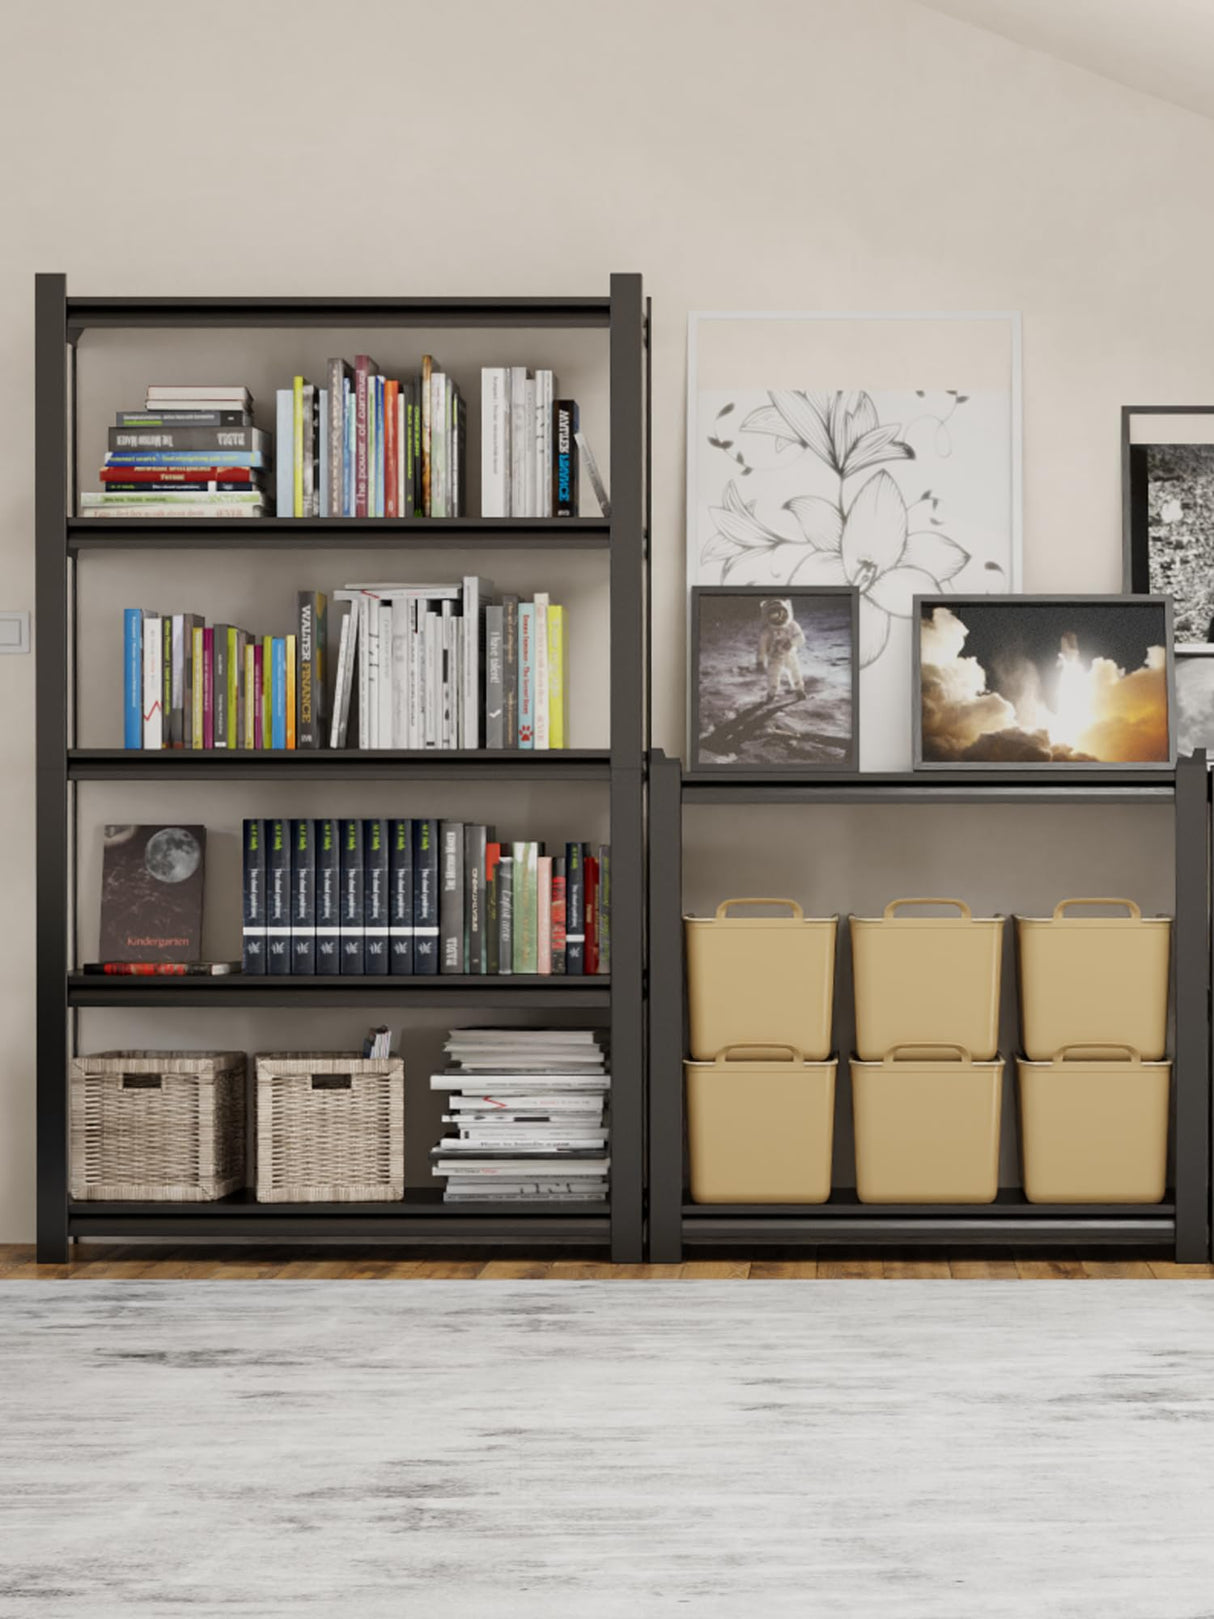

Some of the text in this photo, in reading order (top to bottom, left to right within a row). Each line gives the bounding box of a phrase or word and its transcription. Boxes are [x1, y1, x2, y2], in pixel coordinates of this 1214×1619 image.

[357, 424, 366, 436] of
[358, 442, 367, 479] power
[490, 636, 500, 656] have
[302, 604, 311, 724] WALTER FINANCE
[490, 658, 500, 684] talent!
